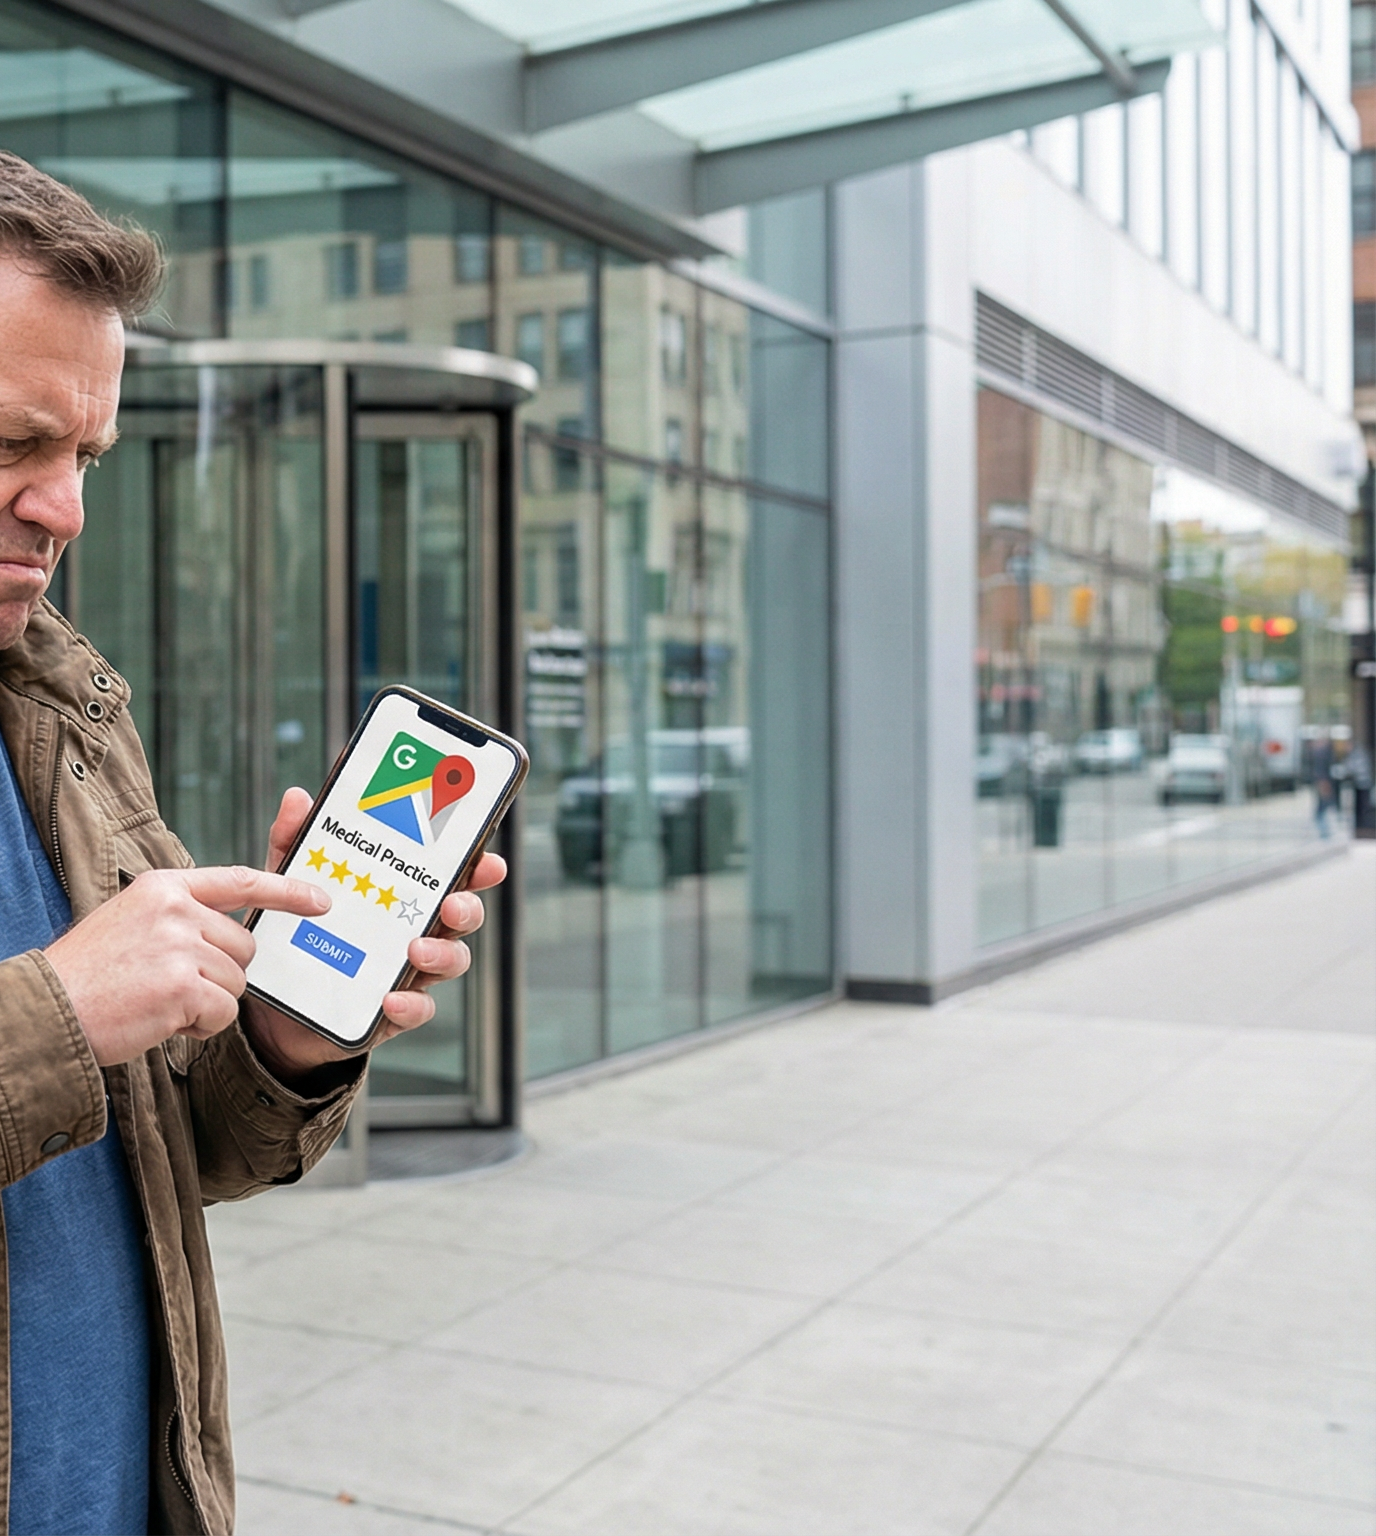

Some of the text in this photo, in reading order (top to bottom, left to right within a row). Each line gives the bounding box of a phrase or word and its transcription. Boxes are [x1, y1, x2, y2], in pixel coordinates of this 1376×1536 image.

[392, 744, 417, 770] G
[321, 816, 440, 891] Medical Practice
[304, 931, 353, 965] SUBMIT
